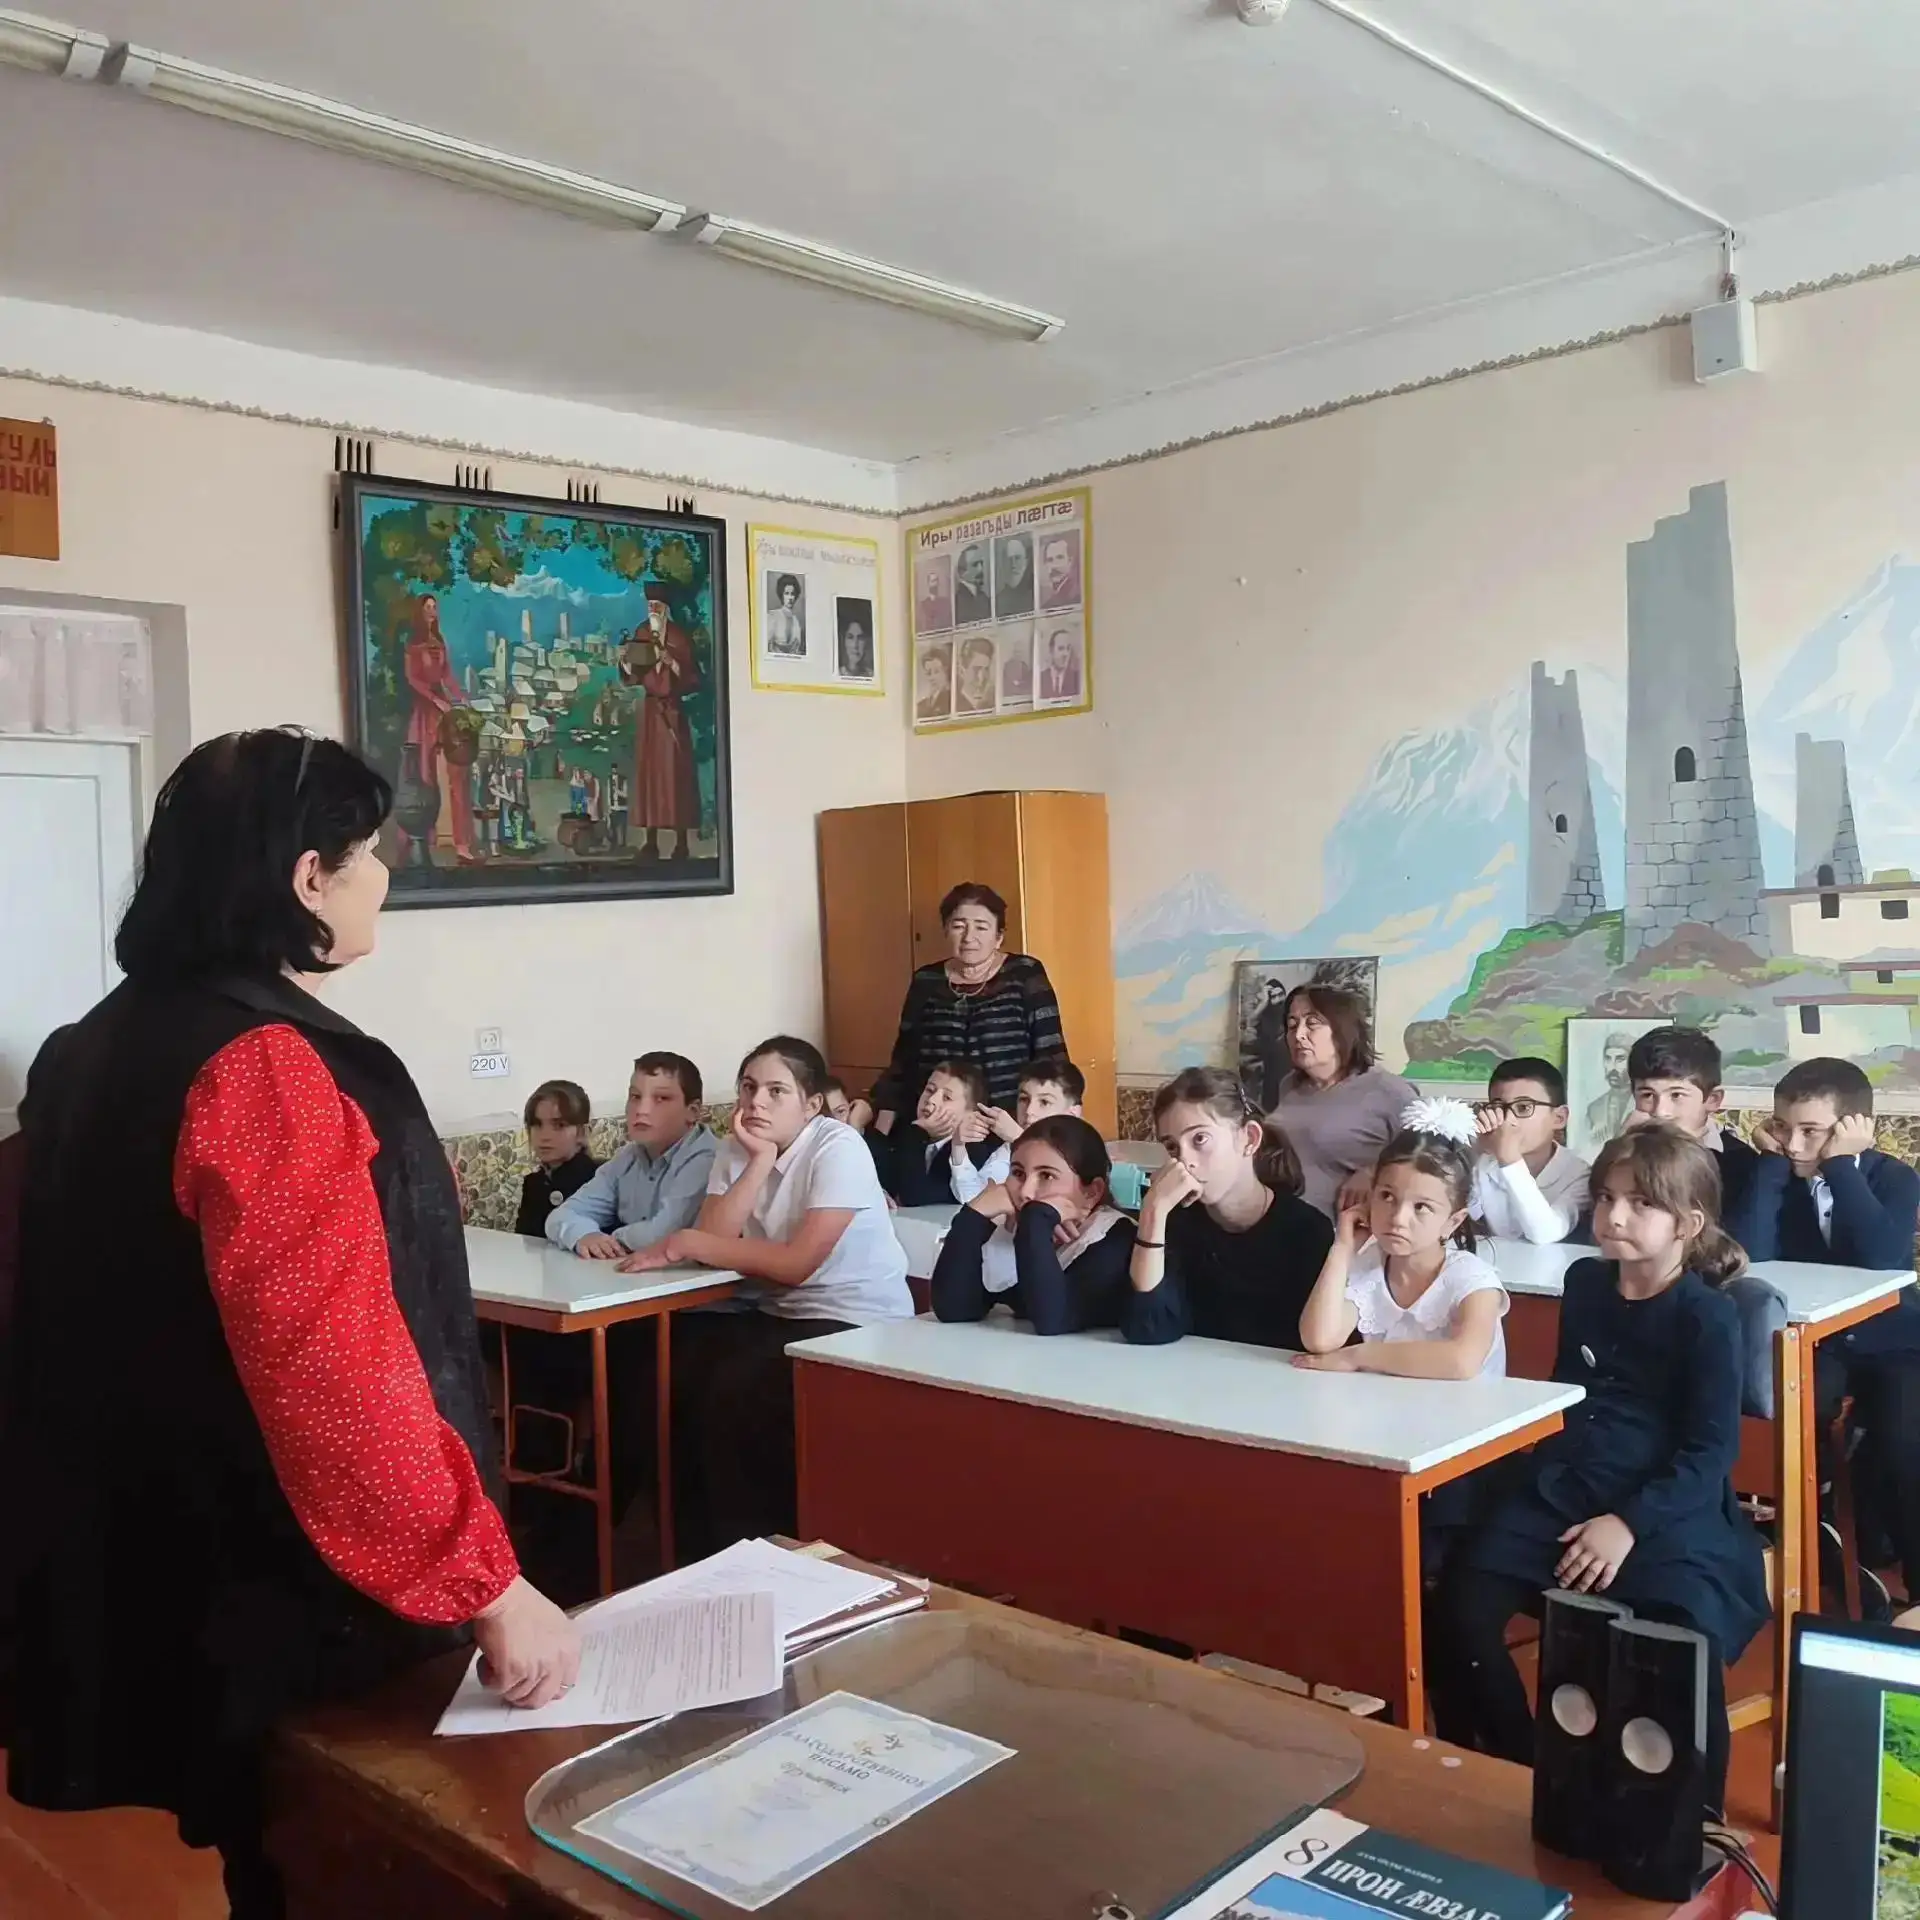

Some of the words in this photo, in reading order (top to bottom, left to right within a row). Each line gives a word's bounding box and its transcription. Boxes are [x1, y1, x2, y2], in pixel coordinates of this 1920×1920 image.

[920, 529, 952, 548] Иры
[471, 1058, 497, 1072] 220
[500, 1057, 508, 1070] V
[808, 1753, 871, 1780] ПИСЬМО
[1283, 1837, 1330, 1866] 8
[1319, 1859, 1406, 1901] ИРОН
